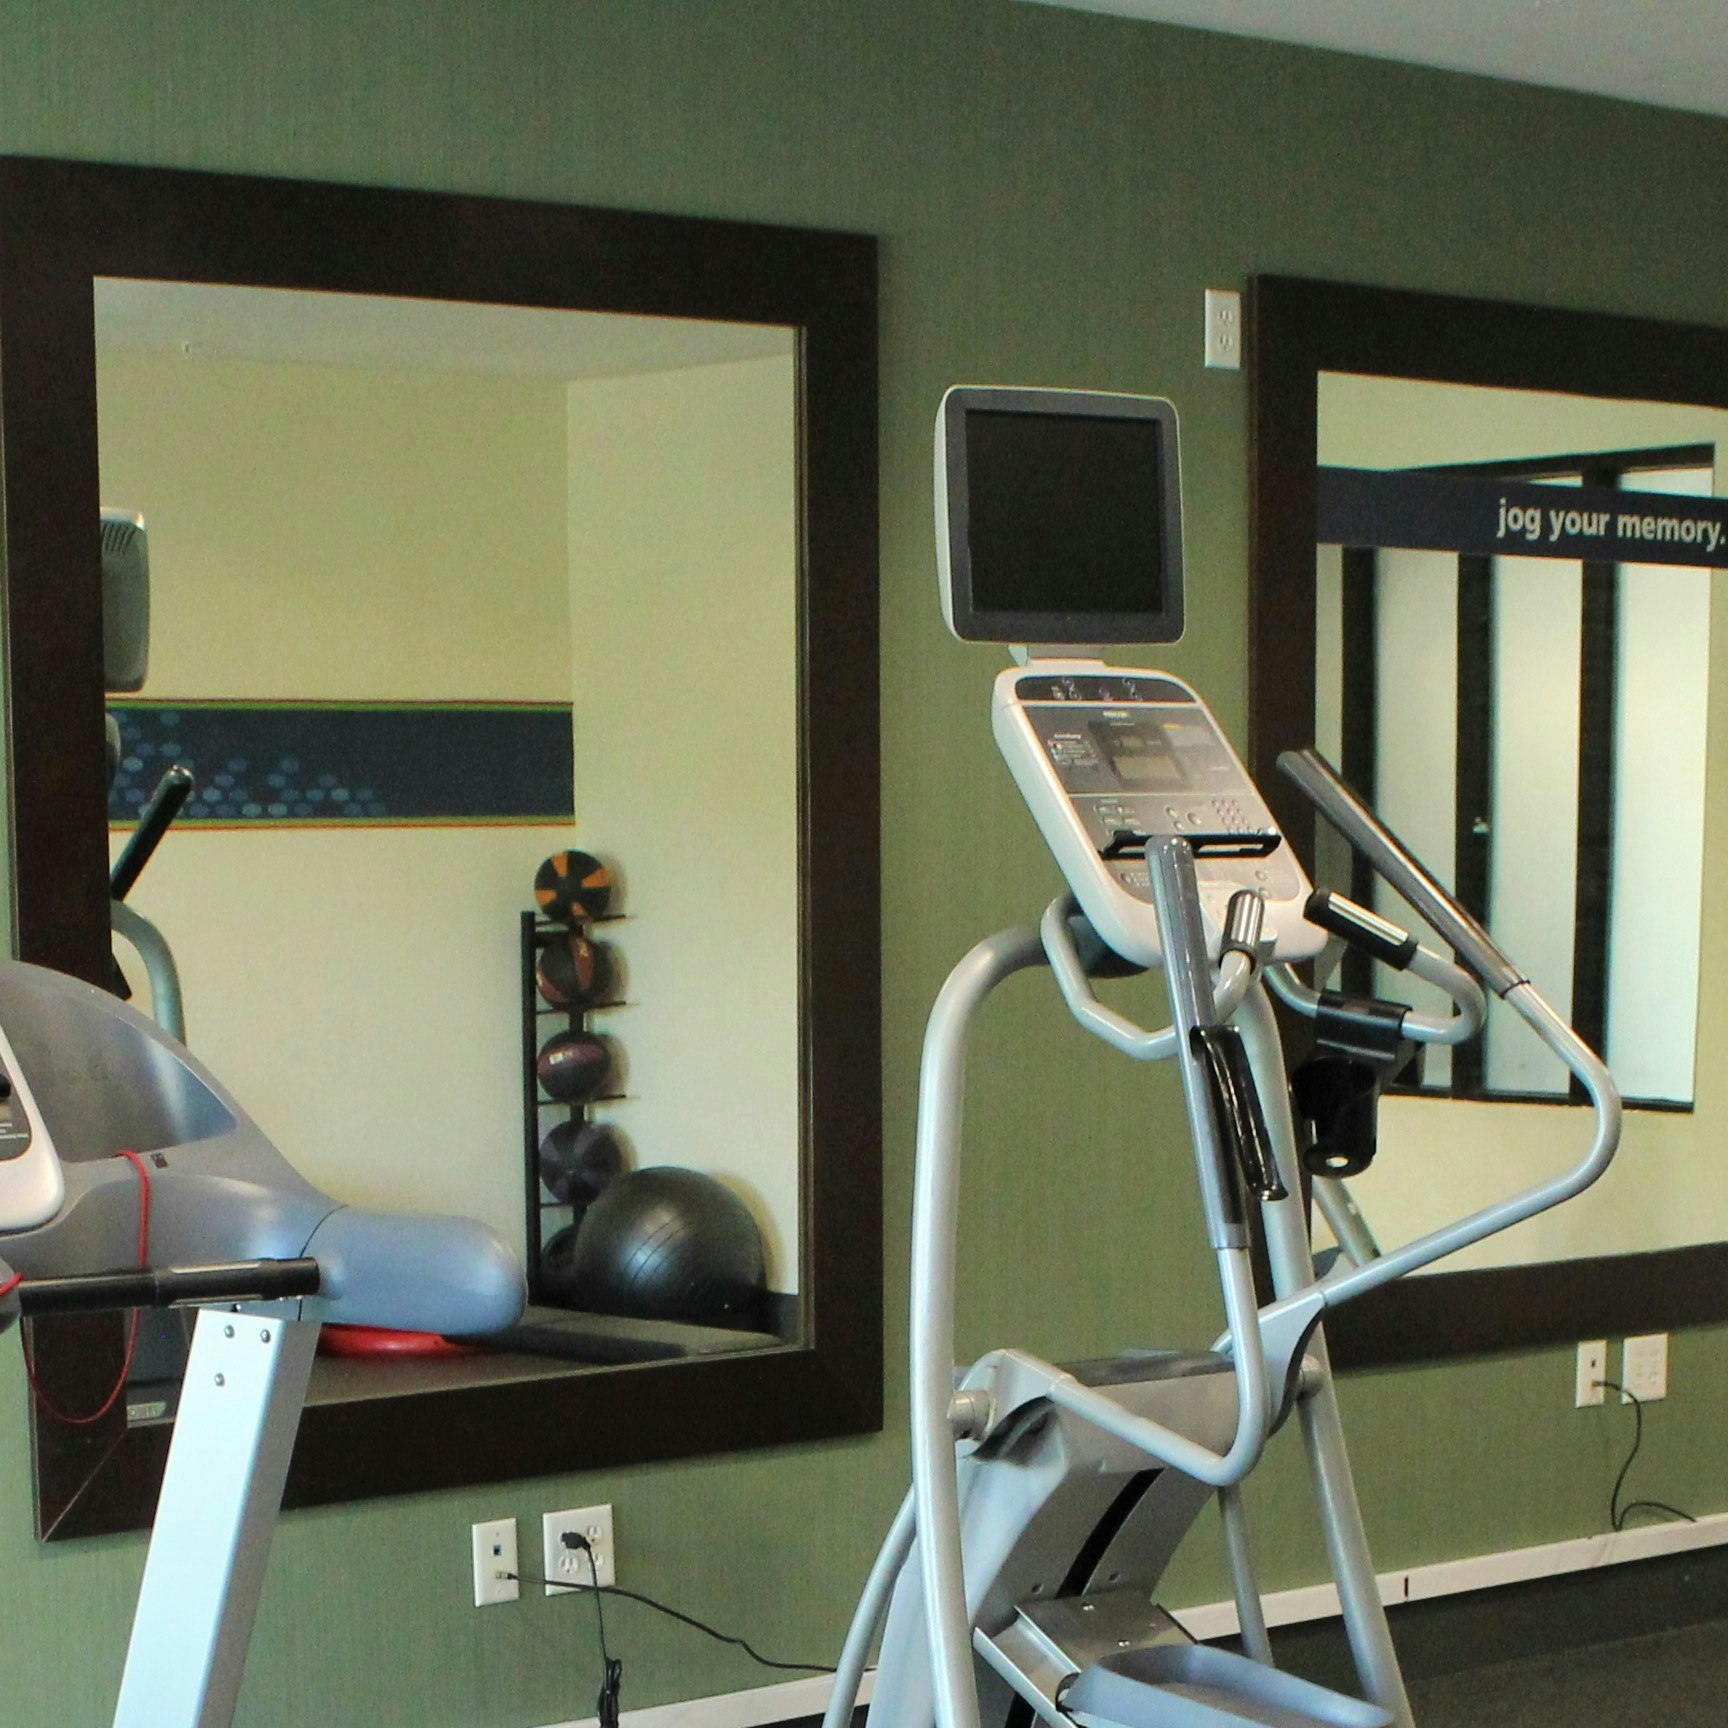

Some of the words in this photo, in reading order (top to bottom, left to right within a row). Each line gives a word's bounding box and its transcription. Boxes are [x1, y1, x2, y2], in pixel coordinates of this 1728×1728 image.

[1496, 497, 1542, 541] jog
[1549, 509, 1611, 543] your
[1616, 513, 1726, 552] memory.
